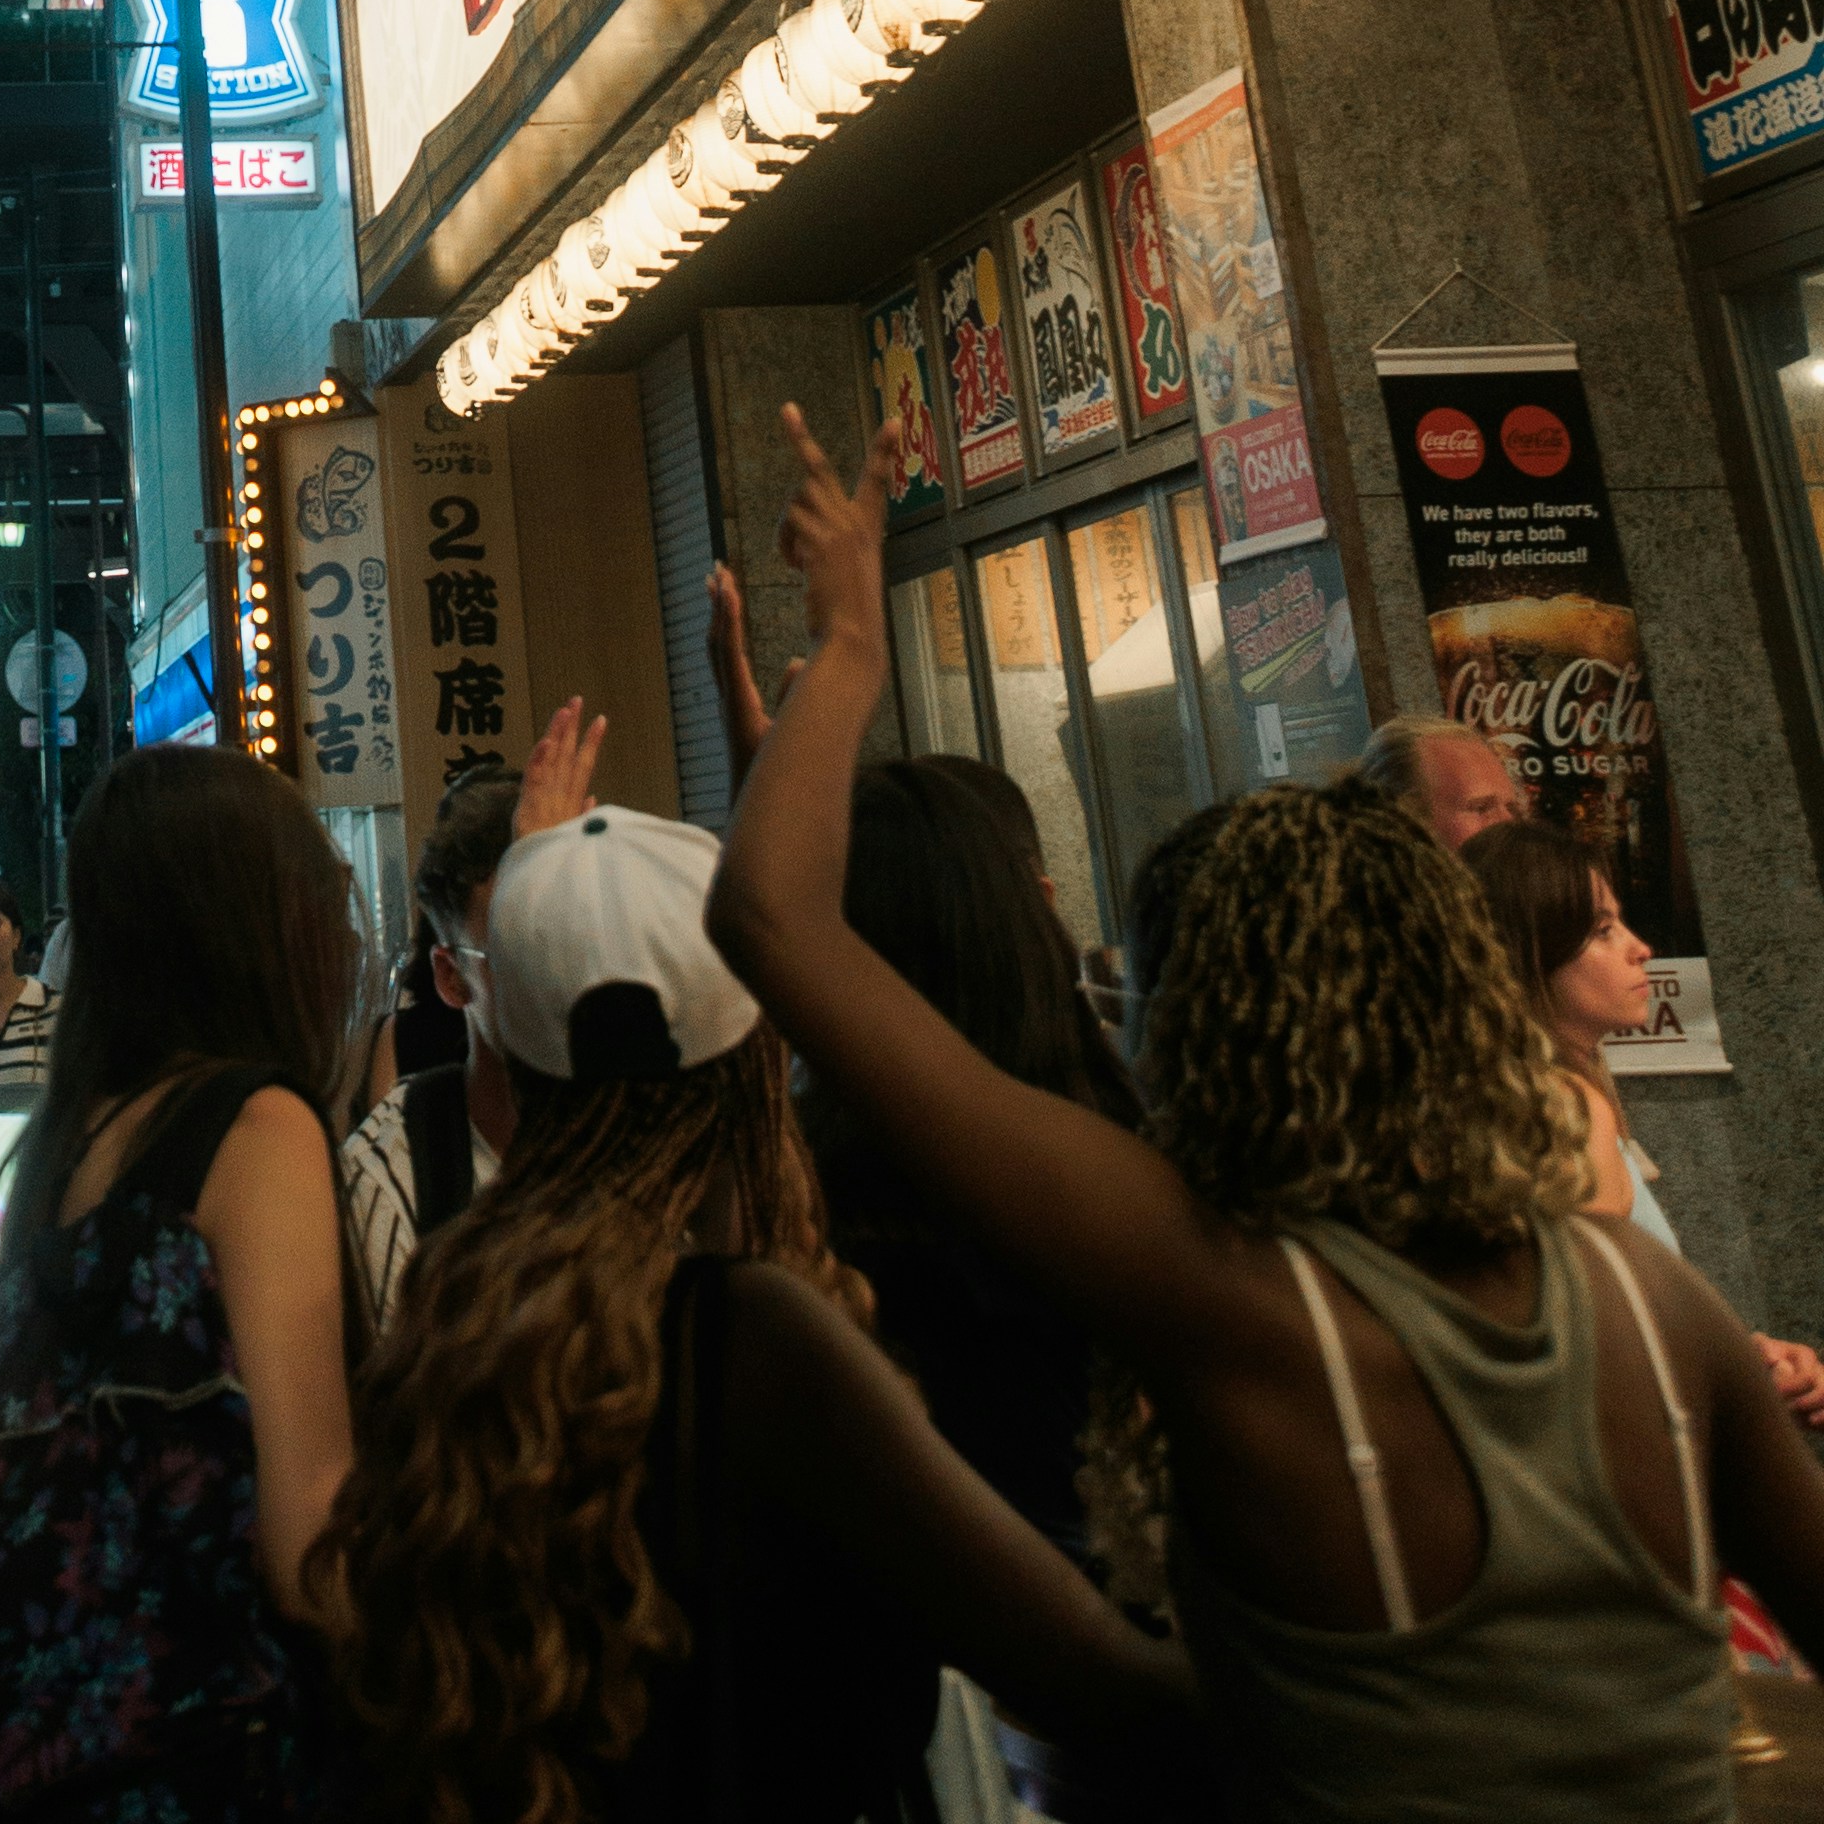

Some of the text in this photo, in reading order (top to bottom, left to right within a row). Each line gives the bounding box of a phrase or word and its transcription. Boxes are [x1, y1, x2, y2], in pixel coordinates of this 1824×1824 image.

[154, 60, 293, 94] STION
[1243, 437, 1312, 494] OSAKA
[1422, 502, 1600, 522] We have two flavors,
[1454, 525, 1566, 547] they are both
[1447, 546, 1589, 570] really delicious!!
[1258, 588, 1279, 617] to
[295, 560, 365, 775] つり吉
[1446, 658, 1657, 748] Coca-Cola
[1506, 754, 1651, 777] RO SUGAR
